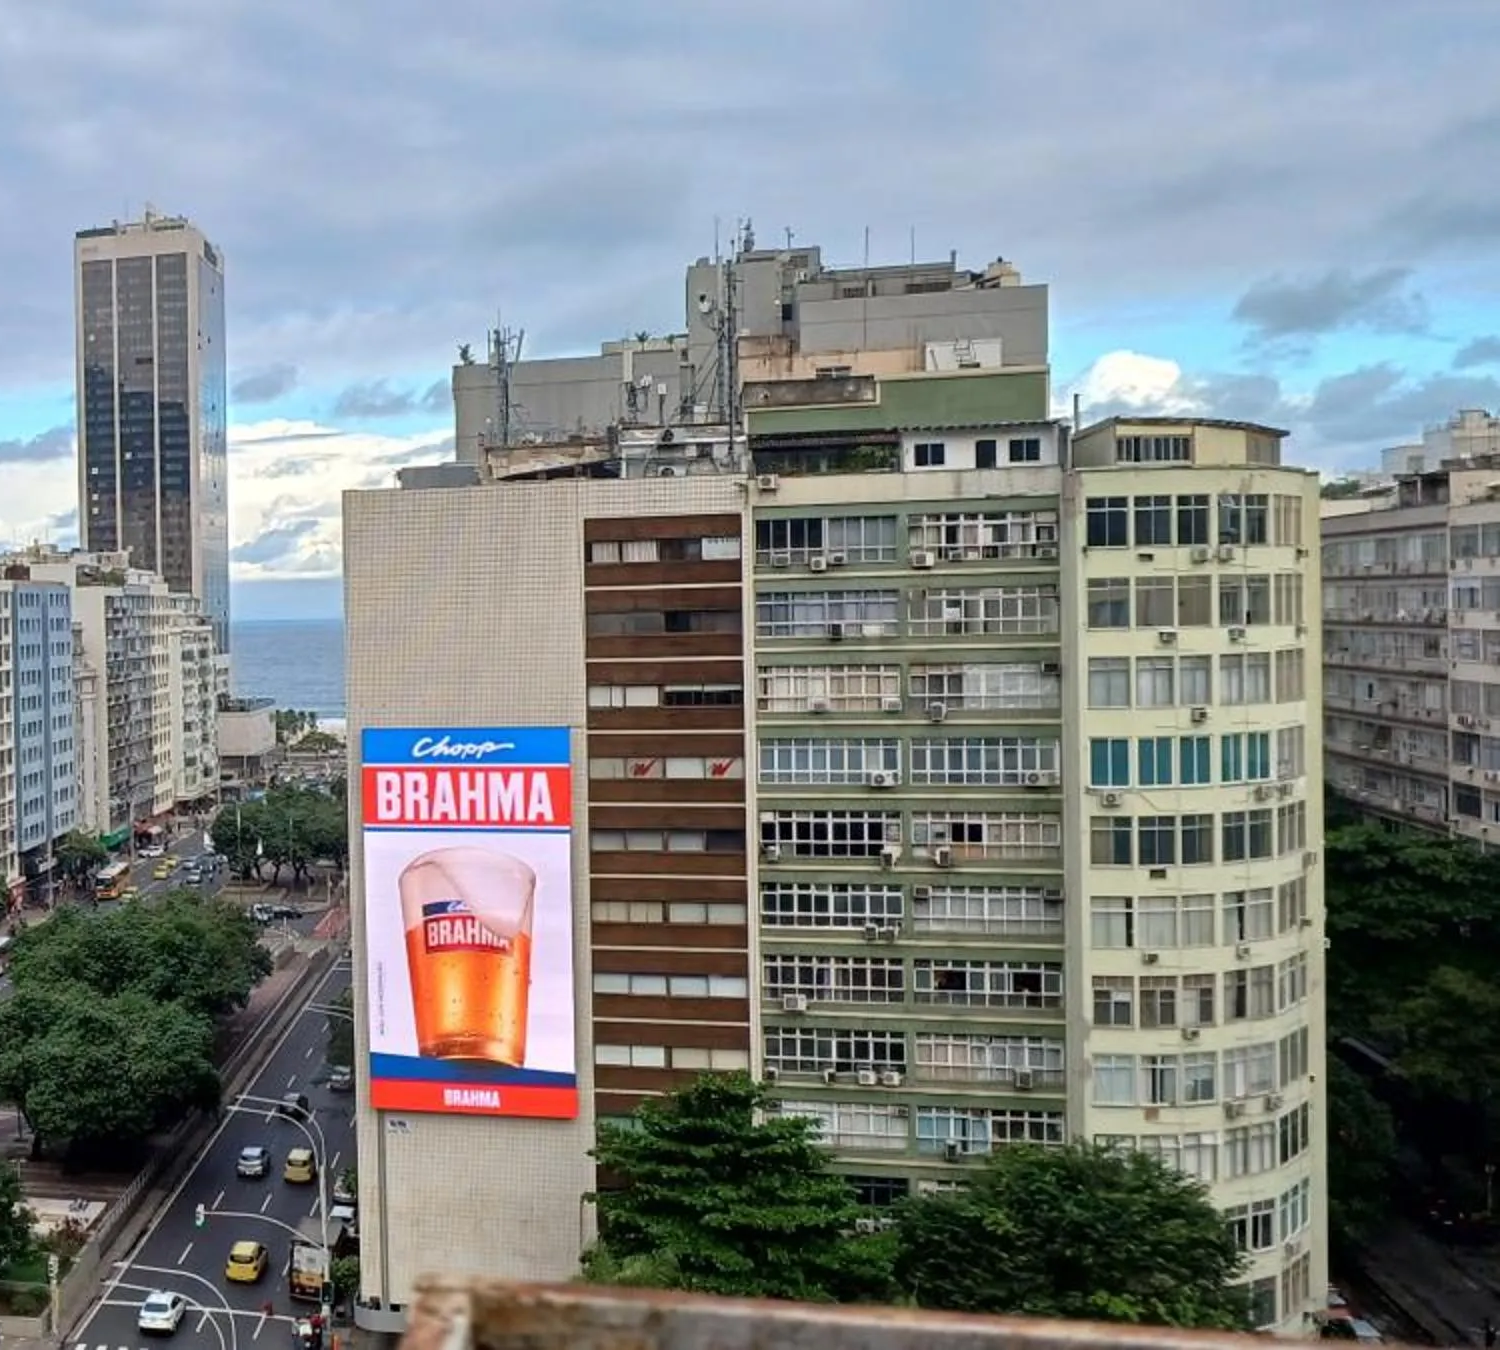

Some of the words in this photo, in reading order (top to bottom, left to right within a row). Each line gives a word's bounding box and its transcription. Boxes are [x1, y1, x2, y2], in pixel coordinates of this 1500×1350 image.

[411, 735, 515, 760] Chopp
[376, 770, 555, 823] BRAHMA
[443, 1088, 500, 1109] BRAHMA
